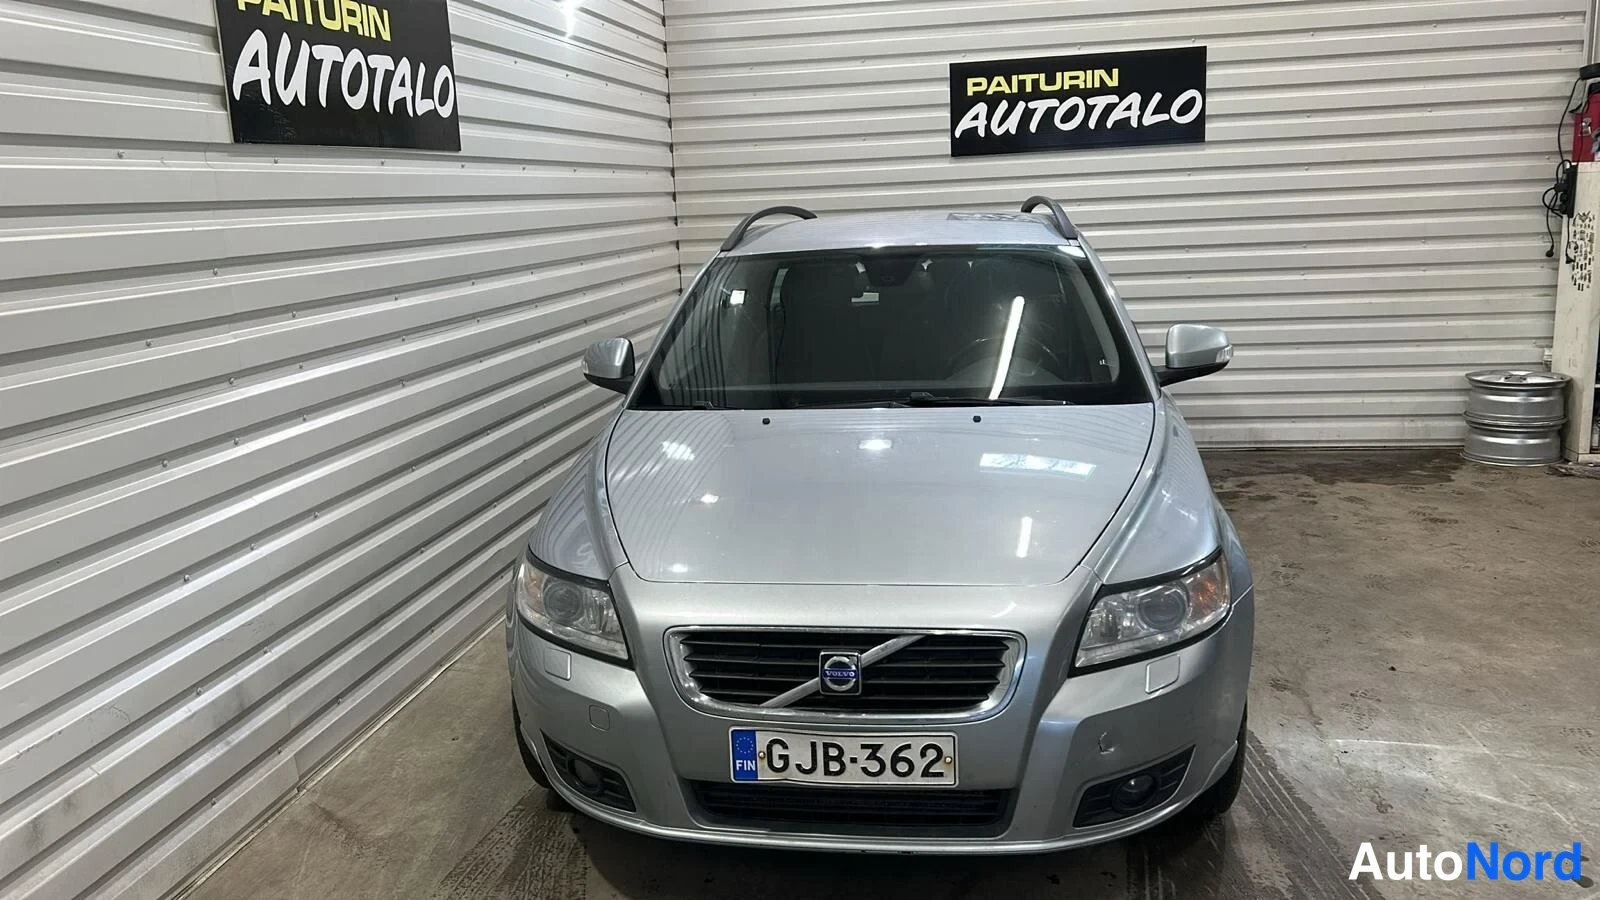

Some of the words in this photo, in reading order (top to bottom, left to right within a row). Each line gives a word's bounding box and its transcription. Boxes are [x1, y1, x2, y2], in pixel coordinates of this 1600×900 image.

[232, 29, 454, 118] AUTOTALO
[966, 68, 1119, 97] PAITURIN
[954, 89, 1203, 138] AUTOTALO
[736, 759, 756, 771] FIN
[766, 738, 945, 778] GJB-362
